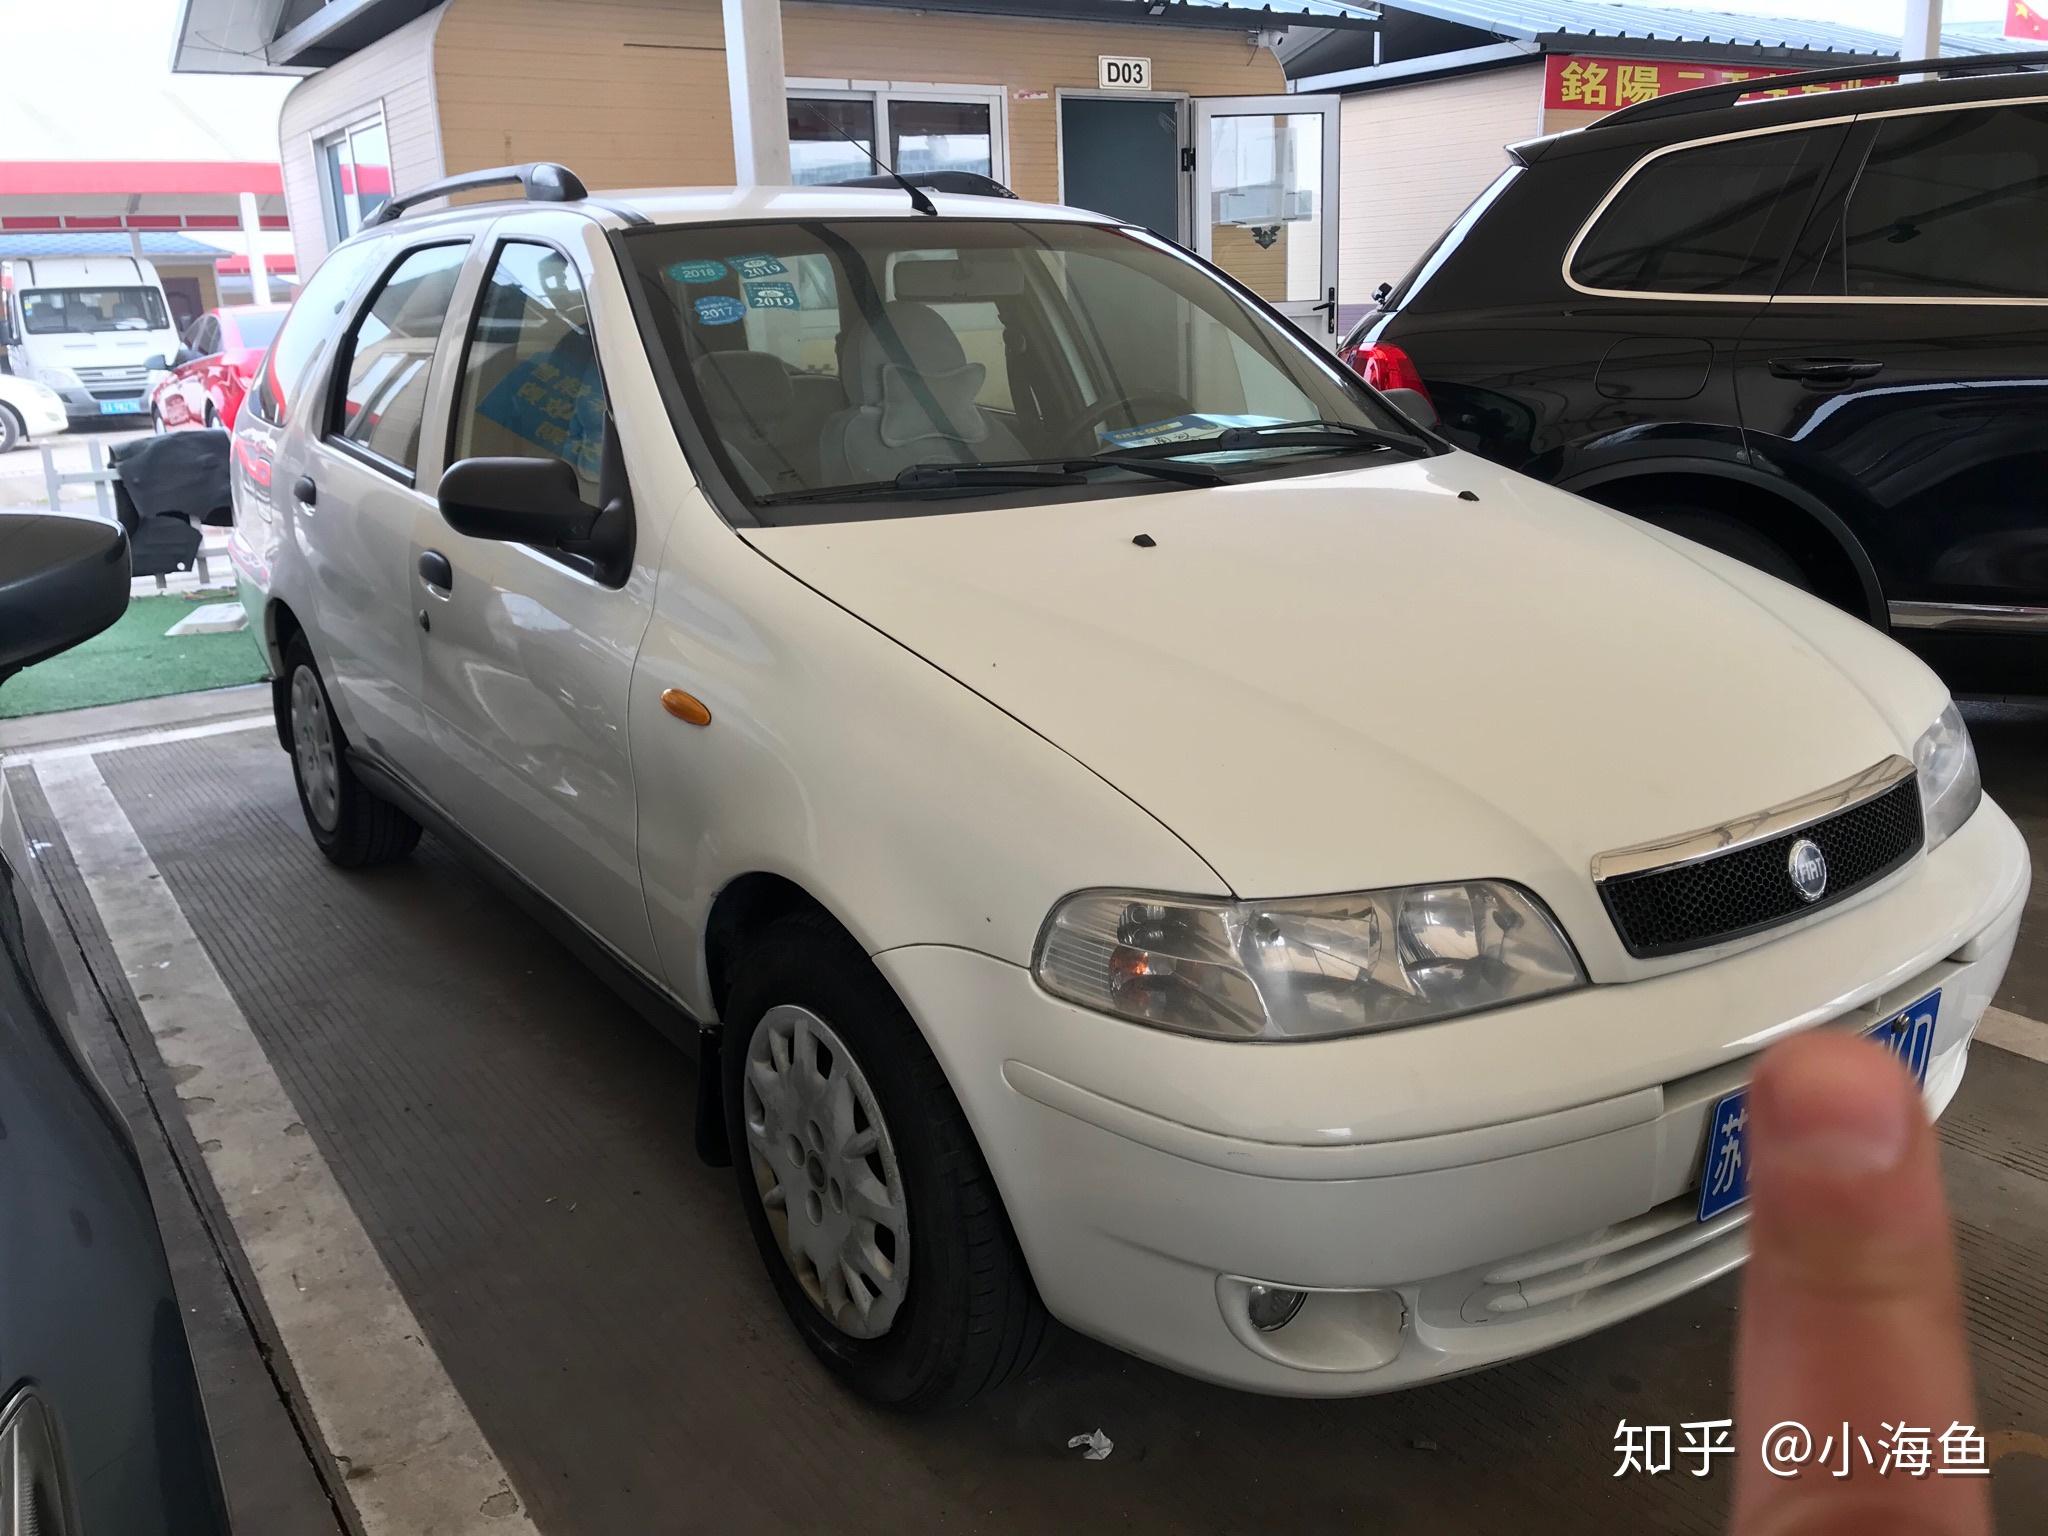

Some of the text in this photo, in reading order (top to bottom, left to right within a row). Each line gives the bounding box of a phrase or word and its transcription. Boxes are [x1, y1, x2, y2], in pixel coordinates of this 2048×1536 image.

[1107, 62, 1143, 83] D03
[682, 268, 715, 279] 2018
[744, 265, 781, 278] 2019
[753, 297, 794, 307] 2019
[700, 306, 733, 320] 2017
[1799, 858, 1823, 883] FIAT
